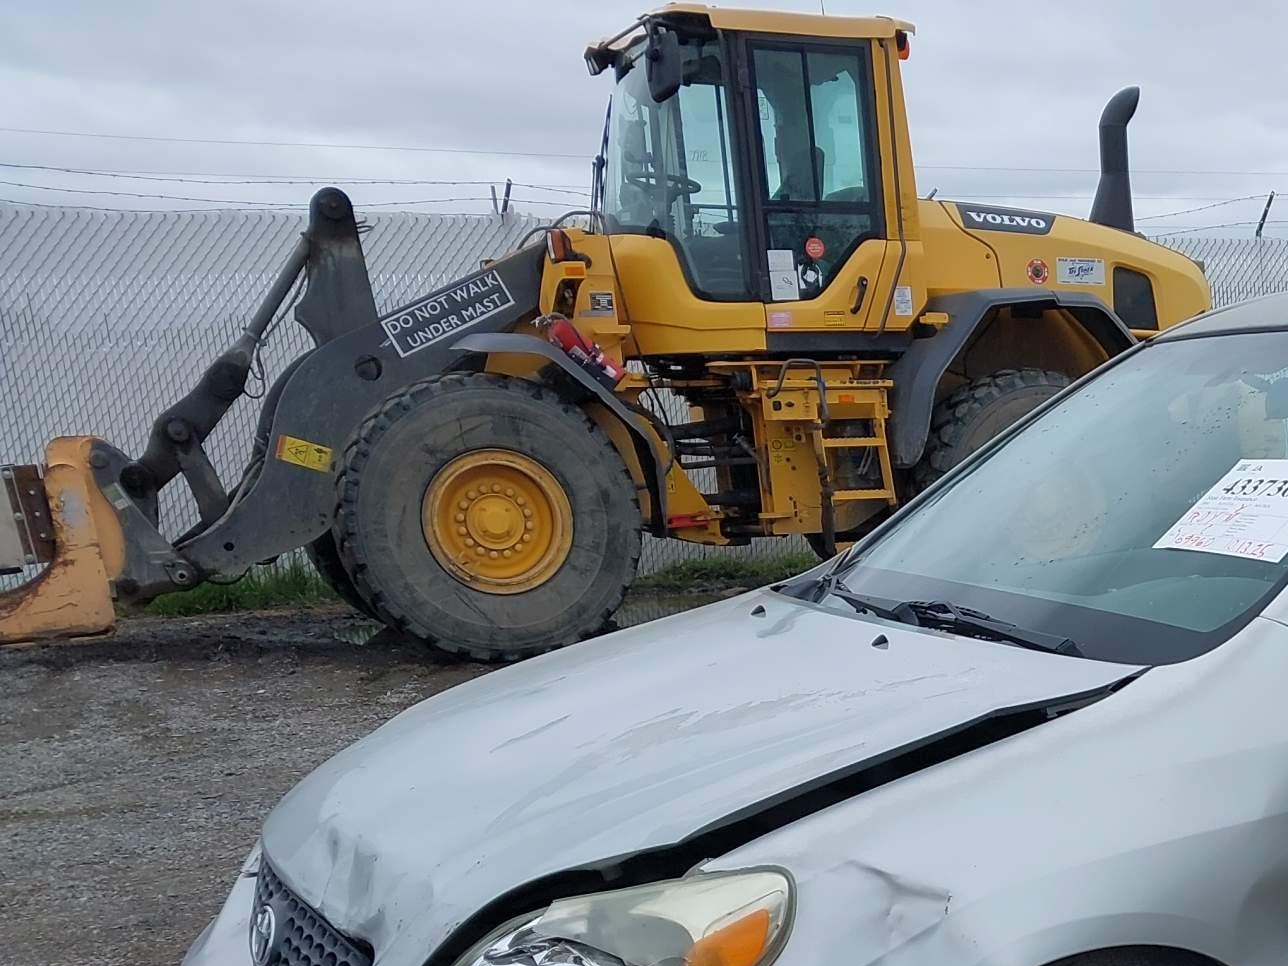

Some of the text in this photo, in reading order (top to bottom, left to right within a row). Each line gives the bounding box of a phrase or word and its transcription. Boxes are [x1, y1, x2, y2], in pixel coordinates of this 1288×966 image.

[966, 211, 1046, 229] VOLVO
[387, 274, 499, 335] DO NOT WALK
[407, 293, 501, 347] UNDER MAST
